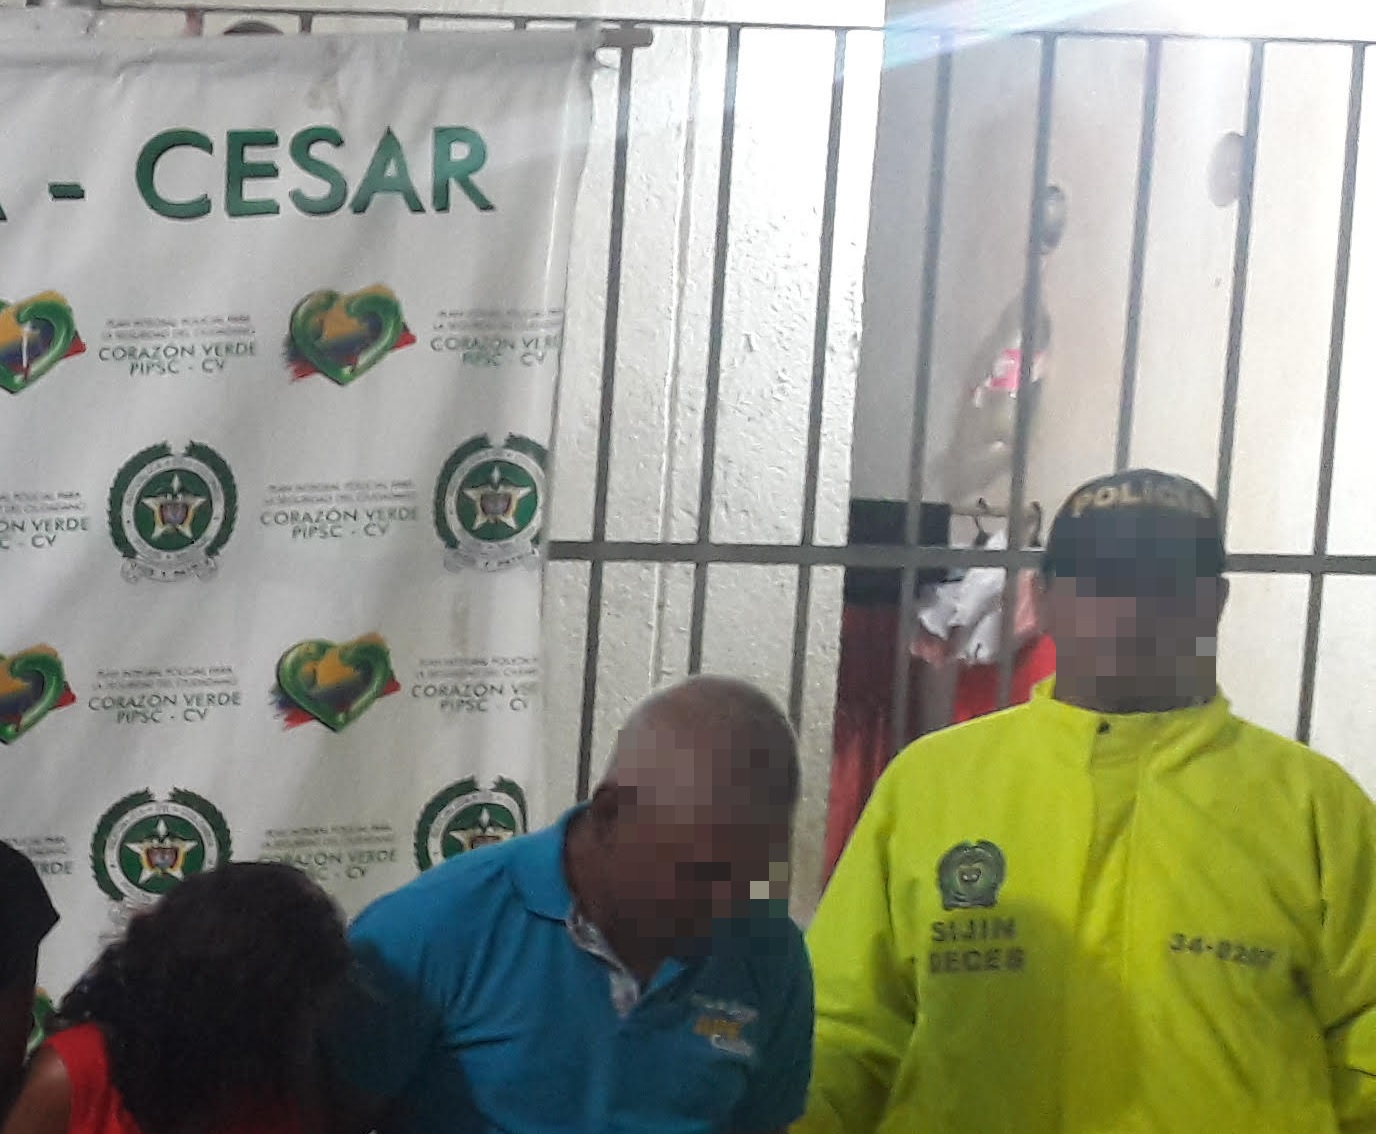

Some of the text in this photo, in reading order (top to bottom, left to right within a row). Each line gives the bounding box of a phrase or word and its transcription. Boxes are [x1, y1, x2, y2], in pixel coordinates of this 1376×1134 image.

[49, 183, 86, 201] -
[136, 125, 495, 220] CESAR
[202, 359, 224, 373] CV
[32, 517, 88, 532] VERDE
[364, 523, 390, 537] CV
[32, 535, 56, 548] CV
[183, 691, 240, 707] VERDE
[184, 709, 207, 722] CV
[930, 917, 1017, 943] SIJIN
